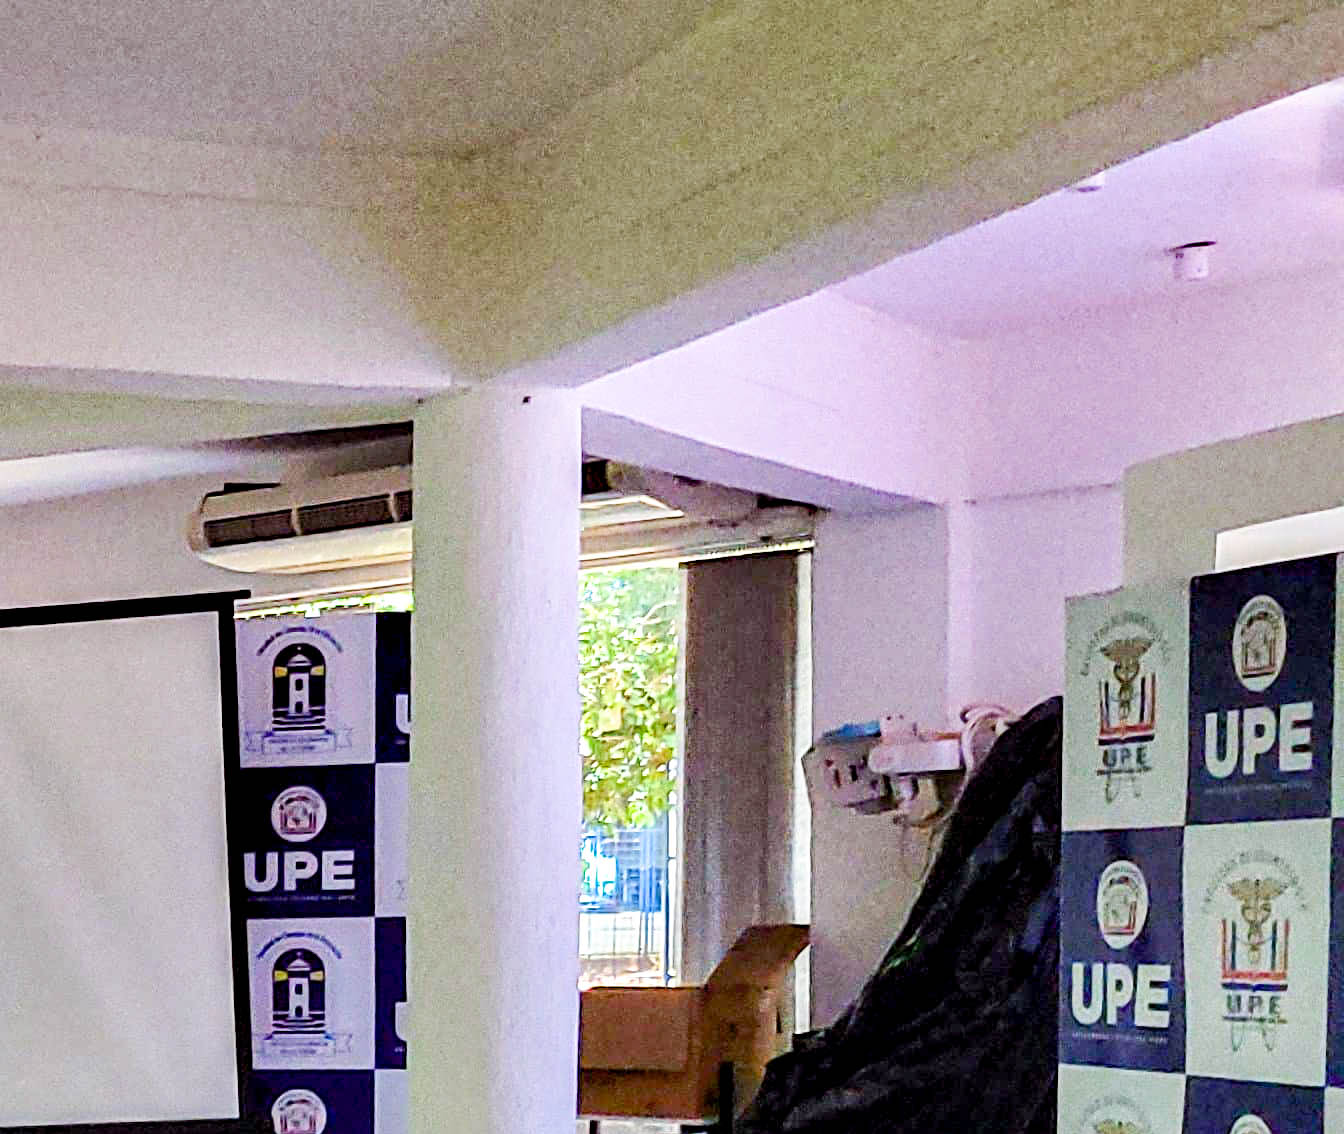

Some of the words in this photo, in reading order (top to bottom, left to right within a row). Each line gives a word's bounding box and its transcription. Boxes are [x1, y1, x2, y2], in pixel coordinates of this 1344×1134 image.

[1103, 746, 1148, 768] UPE
[1205, 701, 1312, 779] UPE
[243, 850, 355, 892] UPE
[1071, 962, 1171, 1028] UPE
[1226, 995, 1281, 1015] UPE
